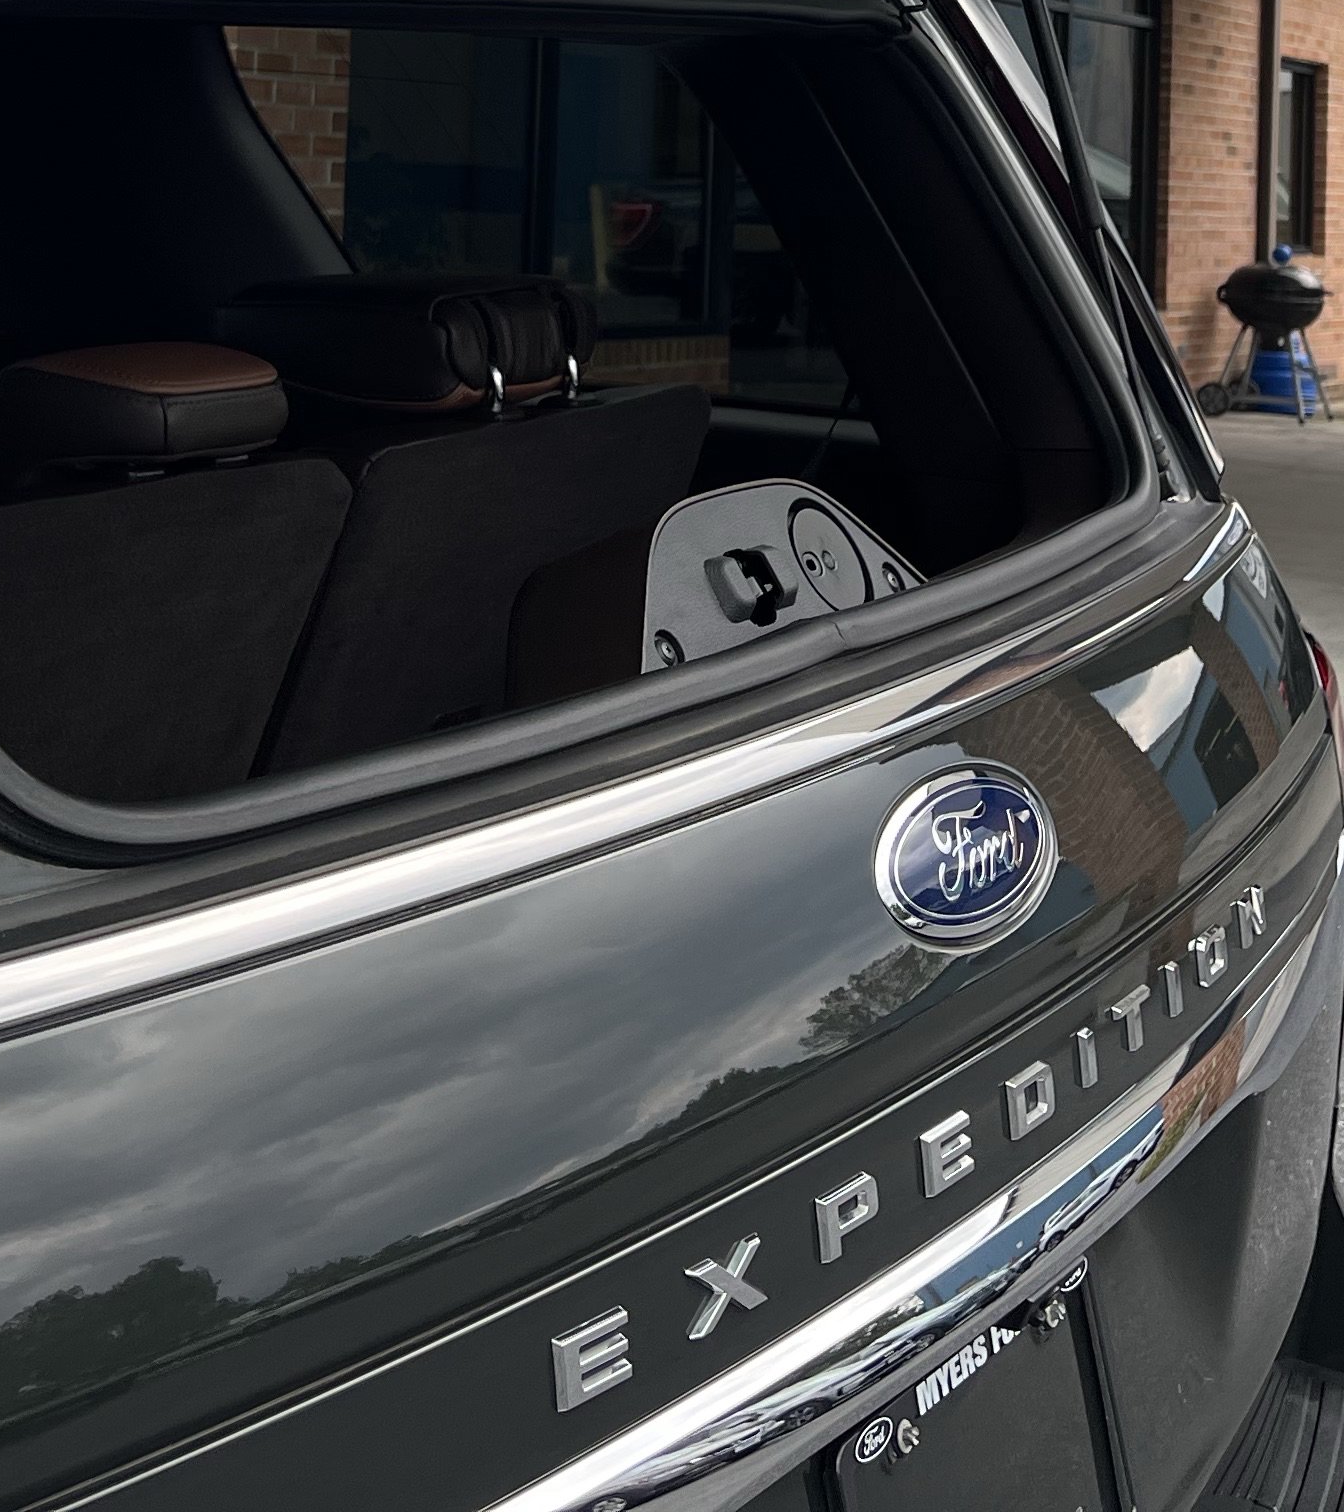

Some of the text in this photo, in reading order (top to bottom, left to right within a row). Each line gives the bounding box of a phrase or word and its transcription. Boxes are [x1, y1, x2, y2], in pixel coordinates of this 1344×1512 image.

[932, 800, 1024, 902] Ford
[551, 885, 1268, 1414] EXPEDITION
[916, 1334, 988, 1416] MYERS
[863, 1425, 886, 1456] Ford
